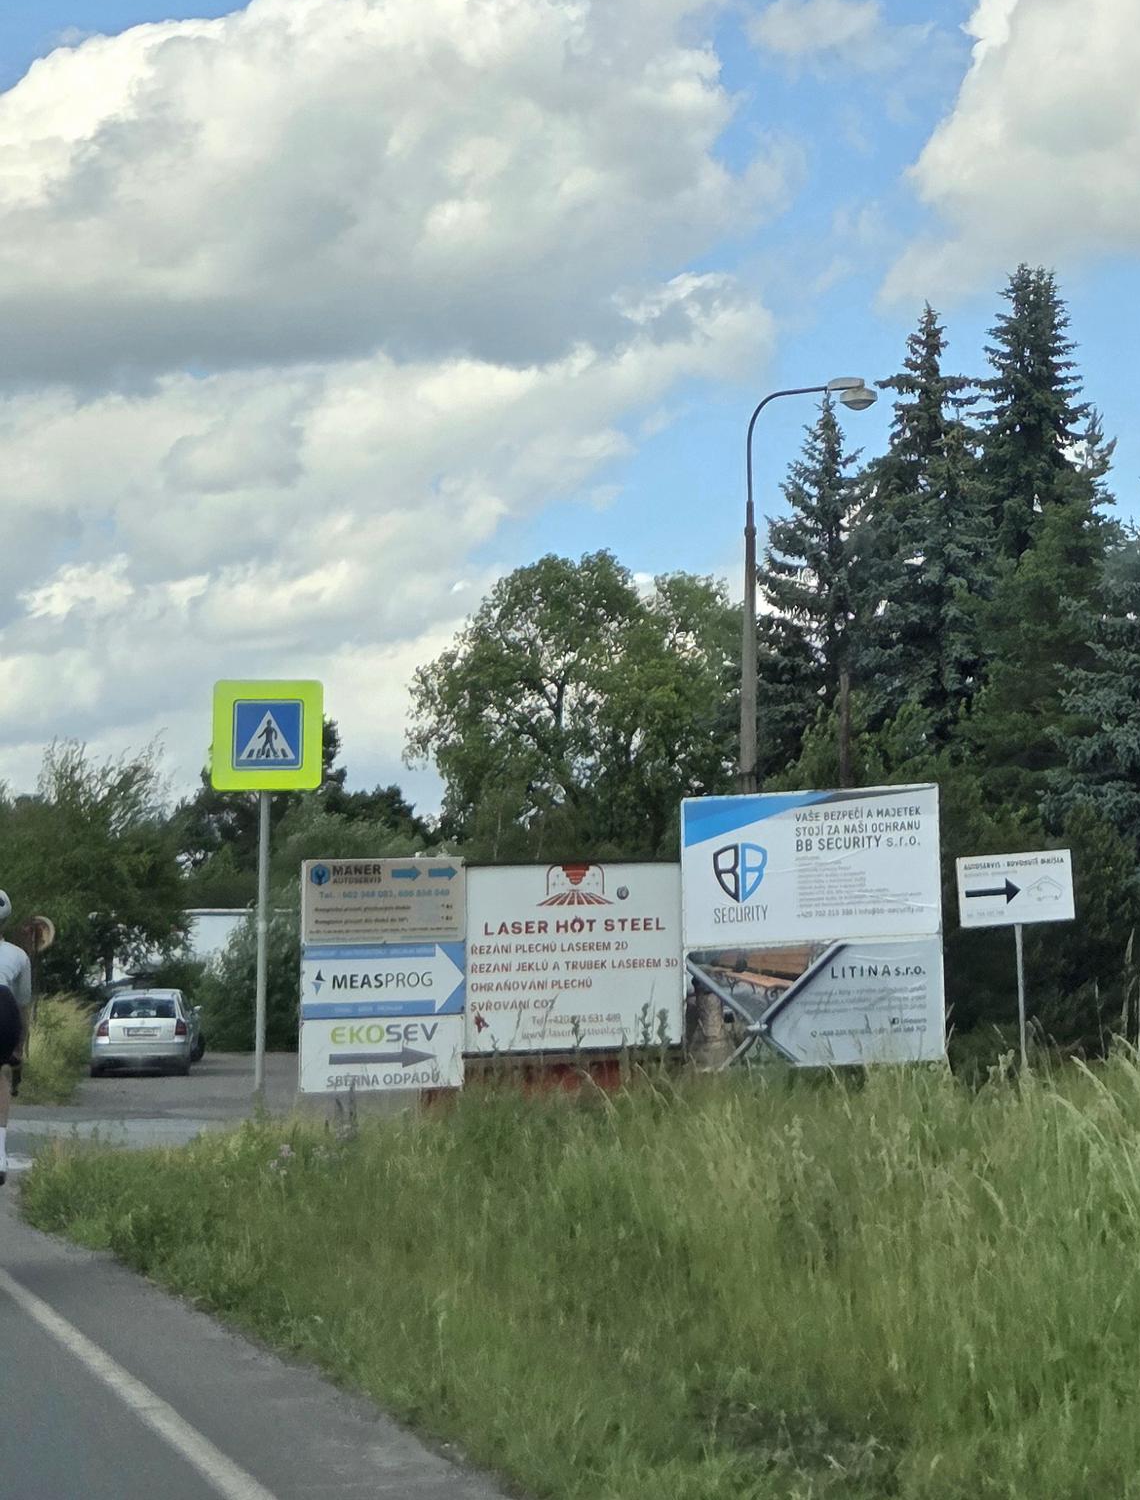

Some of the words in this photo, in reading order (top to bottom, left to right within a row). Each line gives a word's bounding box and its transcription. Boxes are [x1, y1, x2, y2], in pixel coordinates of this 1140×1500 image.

[795, 811, 821, 823] VAŠE
[824, 808, 863, 822] BEZPEČÍ
[866, 809, 873, 818] A
[876, 806, 921, 818] MAJETEK
[795, 823, 825, 836] STOJÍ
[827, 823, 840, 835] ZA
[844, 821, 868, 834] NAŠI
[871, 819, 921, 832] OCHRANU
[795, 838, 813, 852] BB
[817, 834, 881, 851] SECURITY
[886, 835, 921, 848] s.r.o.
[713, 905, 768, 924] SECURITY
[484, 920, 548, 936] LASER
[604, 916, 666, 932] STEEL
[471, 943, 512, 956] ŘEZÁNÍ
[515, 941, 557, 954] PLECHŮ
[560, 942, 611, 953] LASEREM
[615, 941, 628, 951] 2D
[471, 961, 512, 974] ŘEZÁNÍ
[515, 960, 549, 972] JEKLŮ
[552, 961, 561, 971] A
[564, 960, 607, 971] TRUBEK
[611, 958, 662, 970] LASEREM
[665, 957, 679, 968] 3D
[831, 964, 891, 979] LITINA
[895, 965, 926, 977] s.r.o.
[332, 971, 433, 990] MEASPROG
[551, 976, 593, 990] PLECHŮ
[330, 1022, 438, 1045] EKOSEV
[383, 1066, 440, 1085] ODPADŮ
